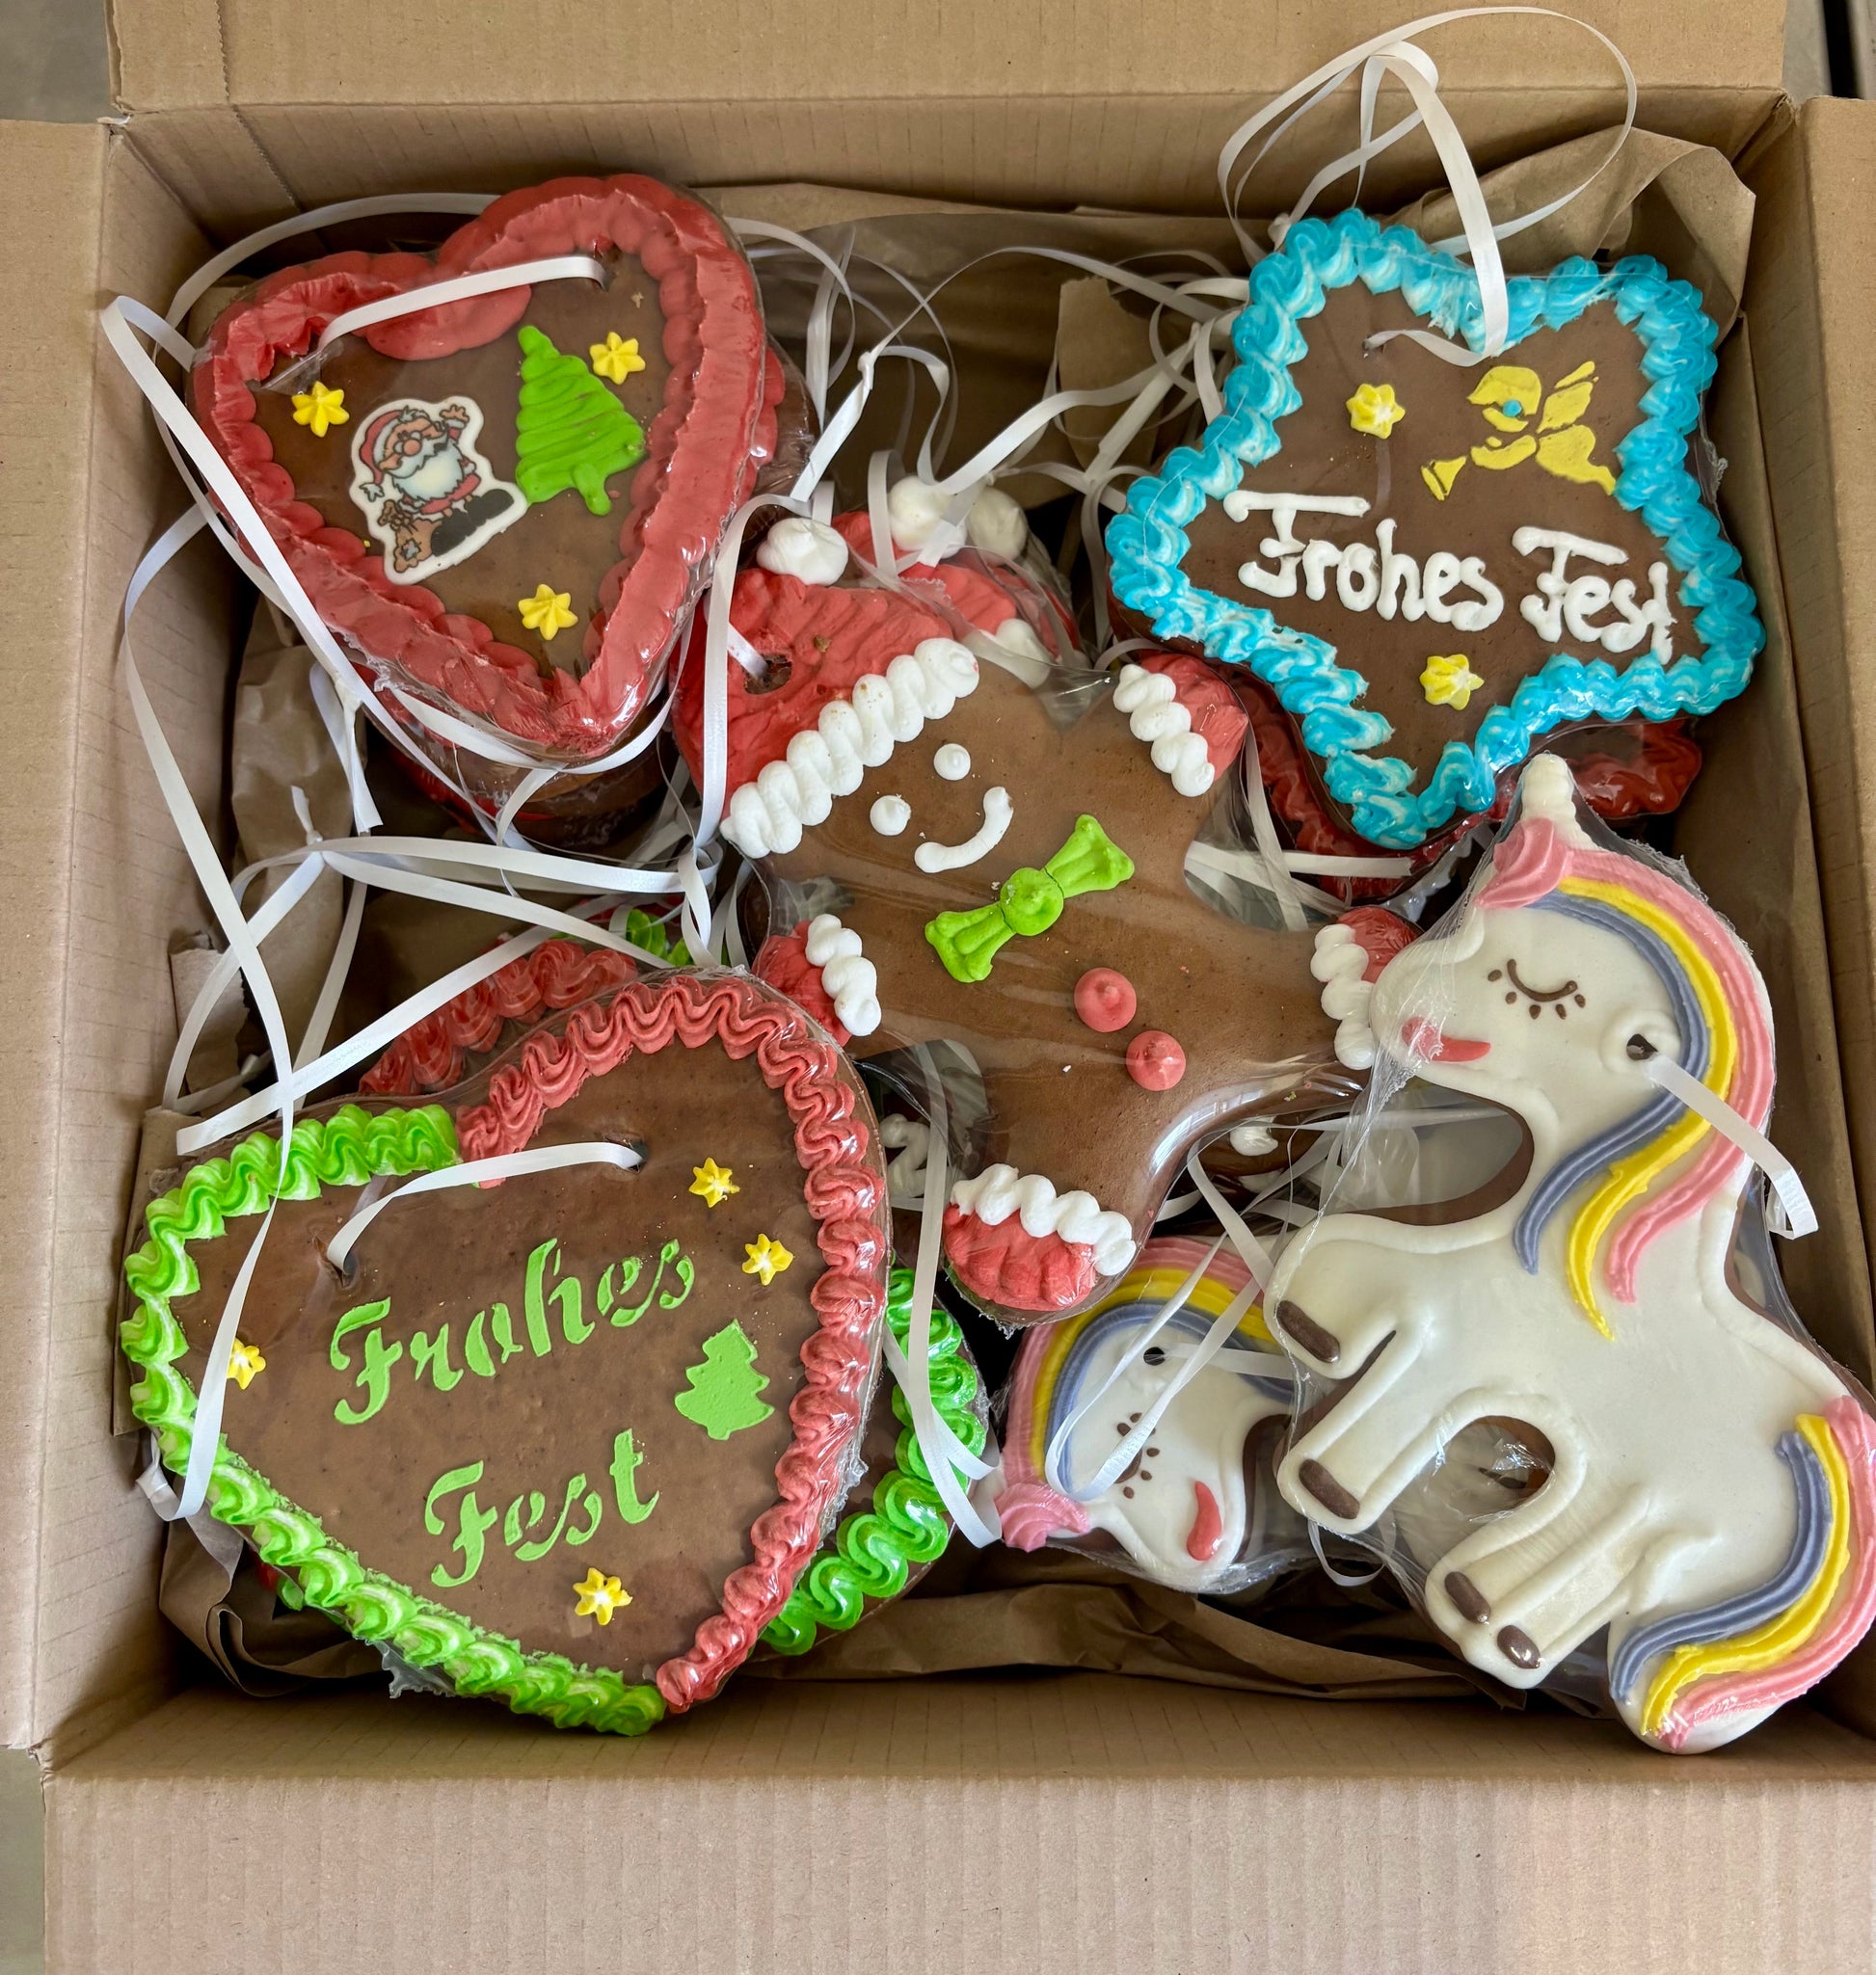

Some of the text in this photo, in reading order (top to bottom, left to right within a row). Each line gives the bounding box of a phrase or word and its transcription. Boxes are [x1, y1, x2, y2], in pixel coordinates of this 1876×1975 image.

[1223, 490, 1677, 665] Frohes Fest
[330, 1238, 695, 1425] Frohes
[424, 1428, 660, 1588] Fest
